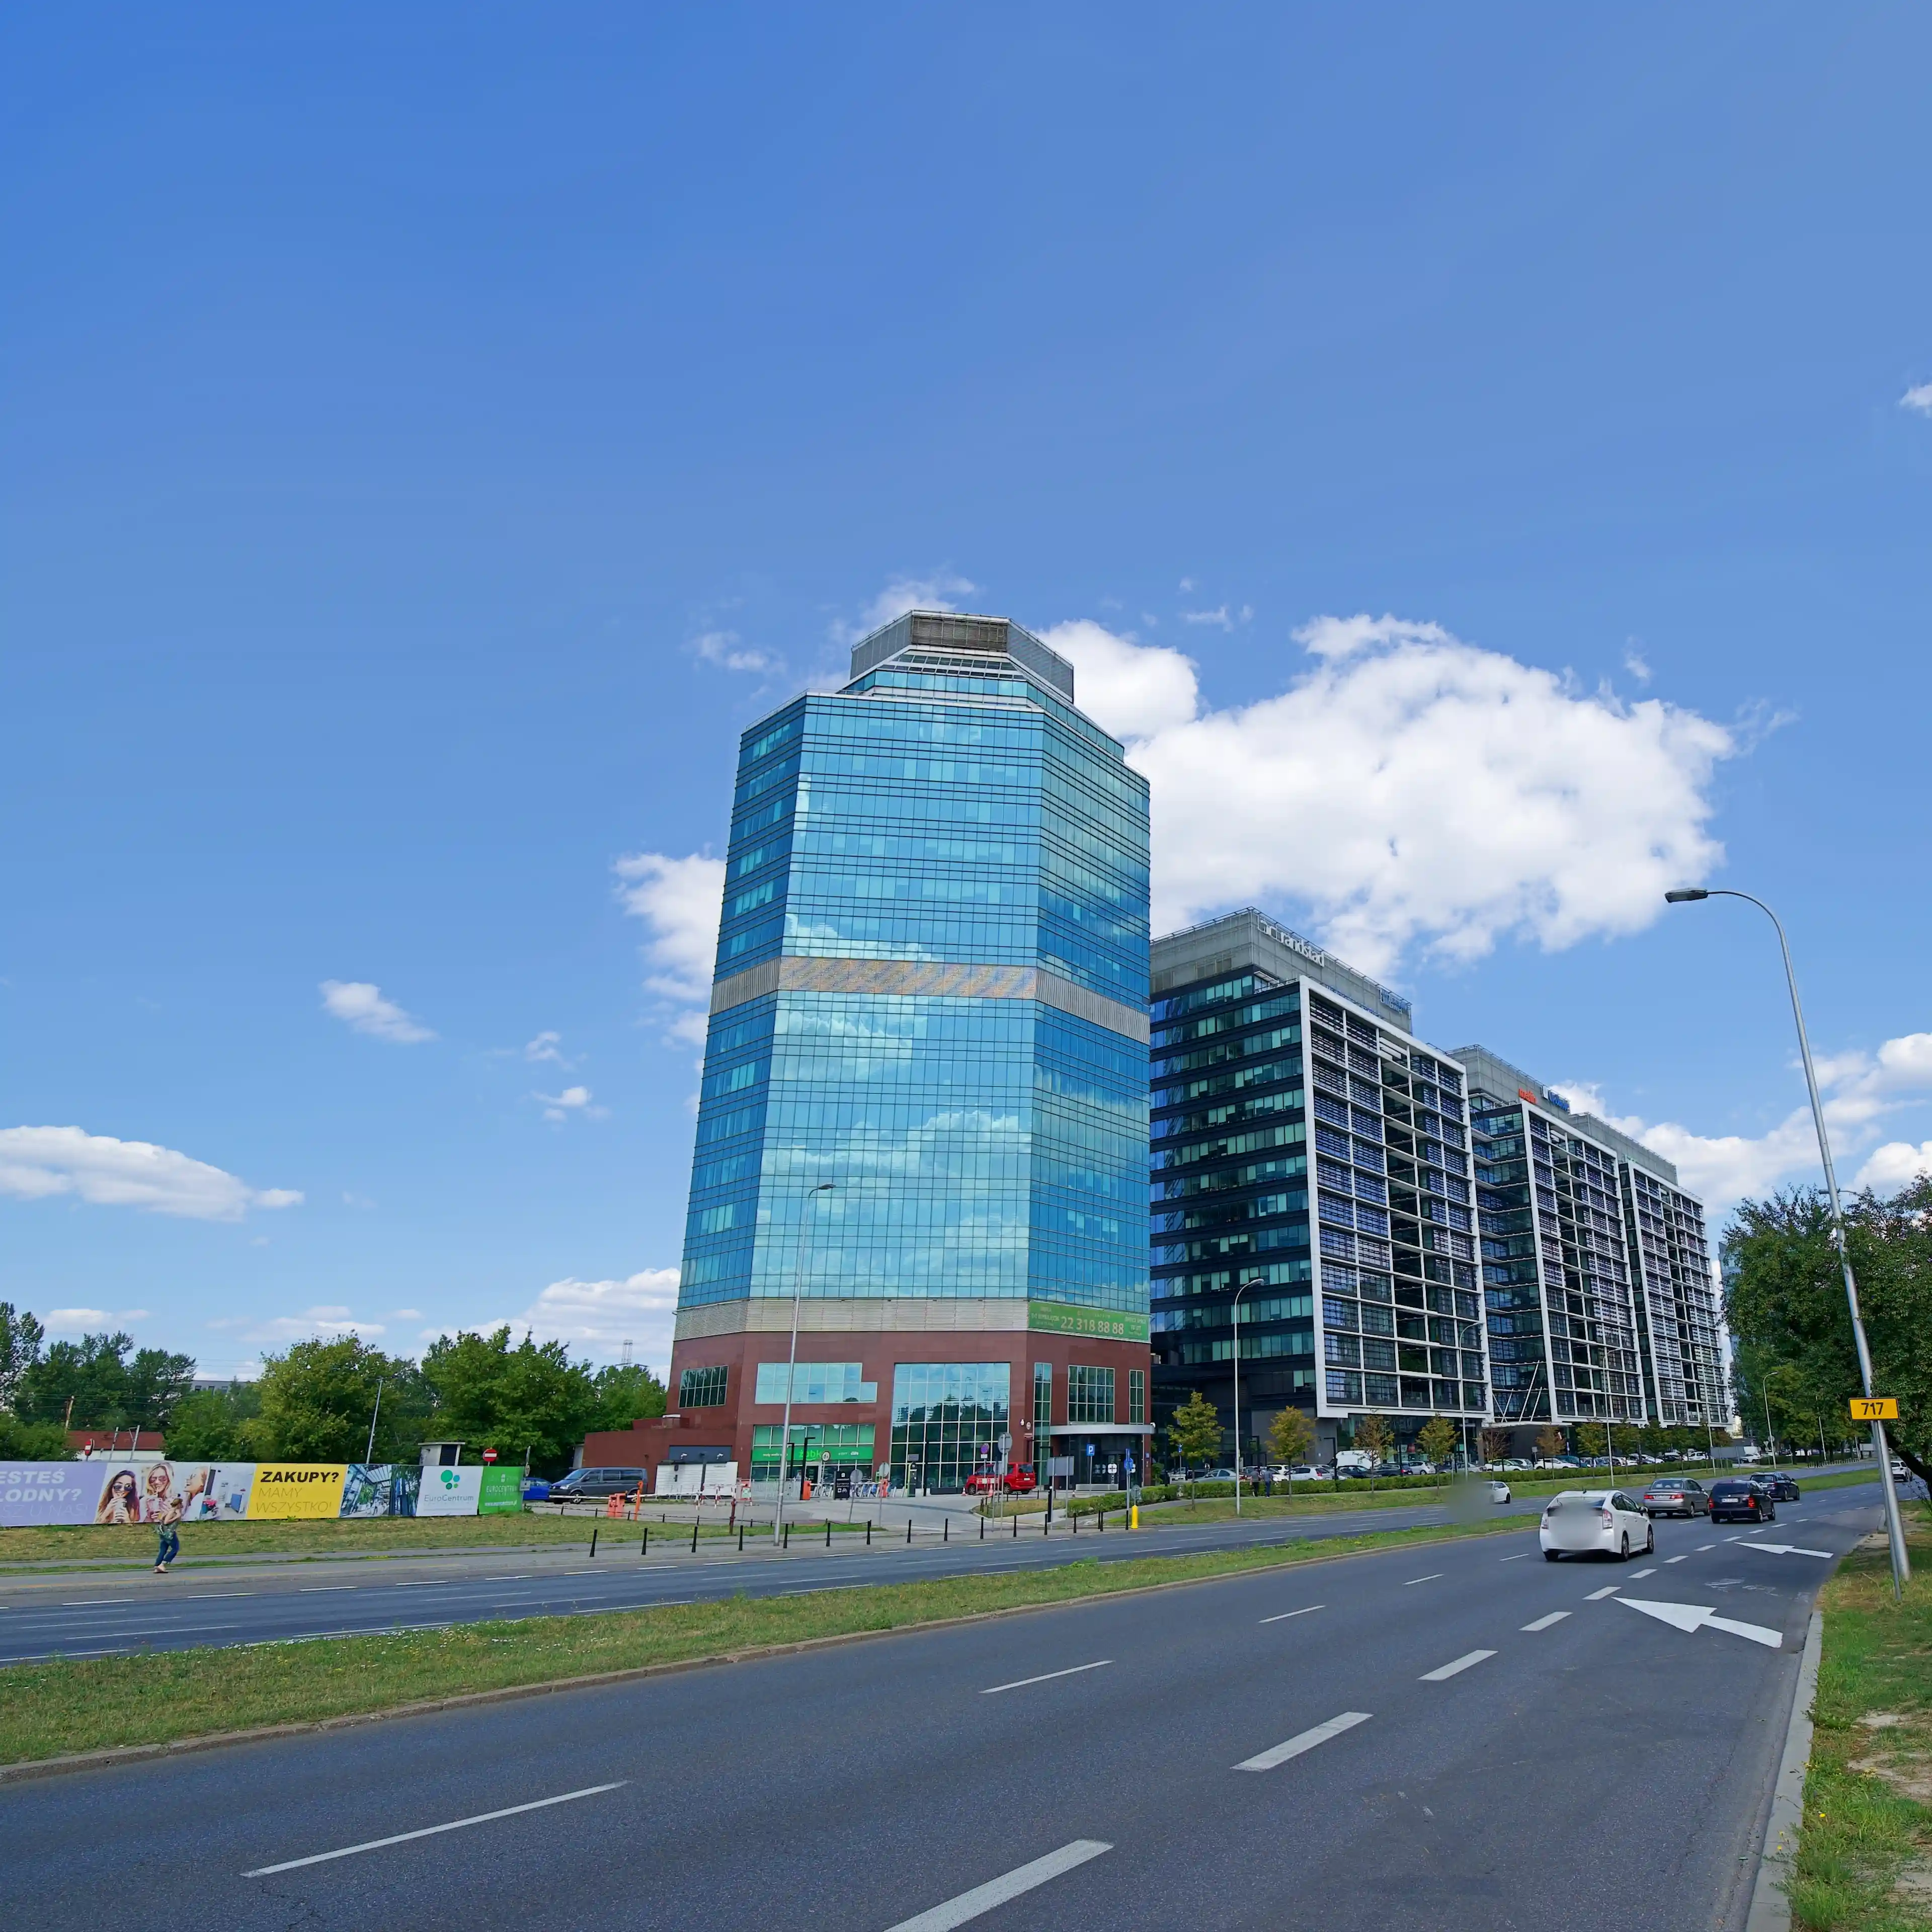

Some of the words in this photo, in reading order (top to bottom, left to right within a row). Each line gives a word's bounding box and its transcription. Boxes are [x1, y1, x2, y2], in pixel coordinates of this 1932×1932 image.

[1280, 931, 1325, 968] randstad
[1061, 1316, 1074, 1330] 22
[1076, 1318, 1095, 1332] 318
[1098, 1321, 1110, 1333] 88
[1112, 1322, 1124, 1335] 88
[1861, 1402, 1884, 1415] 717
[799, 1450, 822, 1458] żabk
[260, 1471, 339, 1483] ZAKUPY?
[259, 1487, 302, 1498] MAMY
[256, 1501, 332, 1513] WSZYSTKO!
